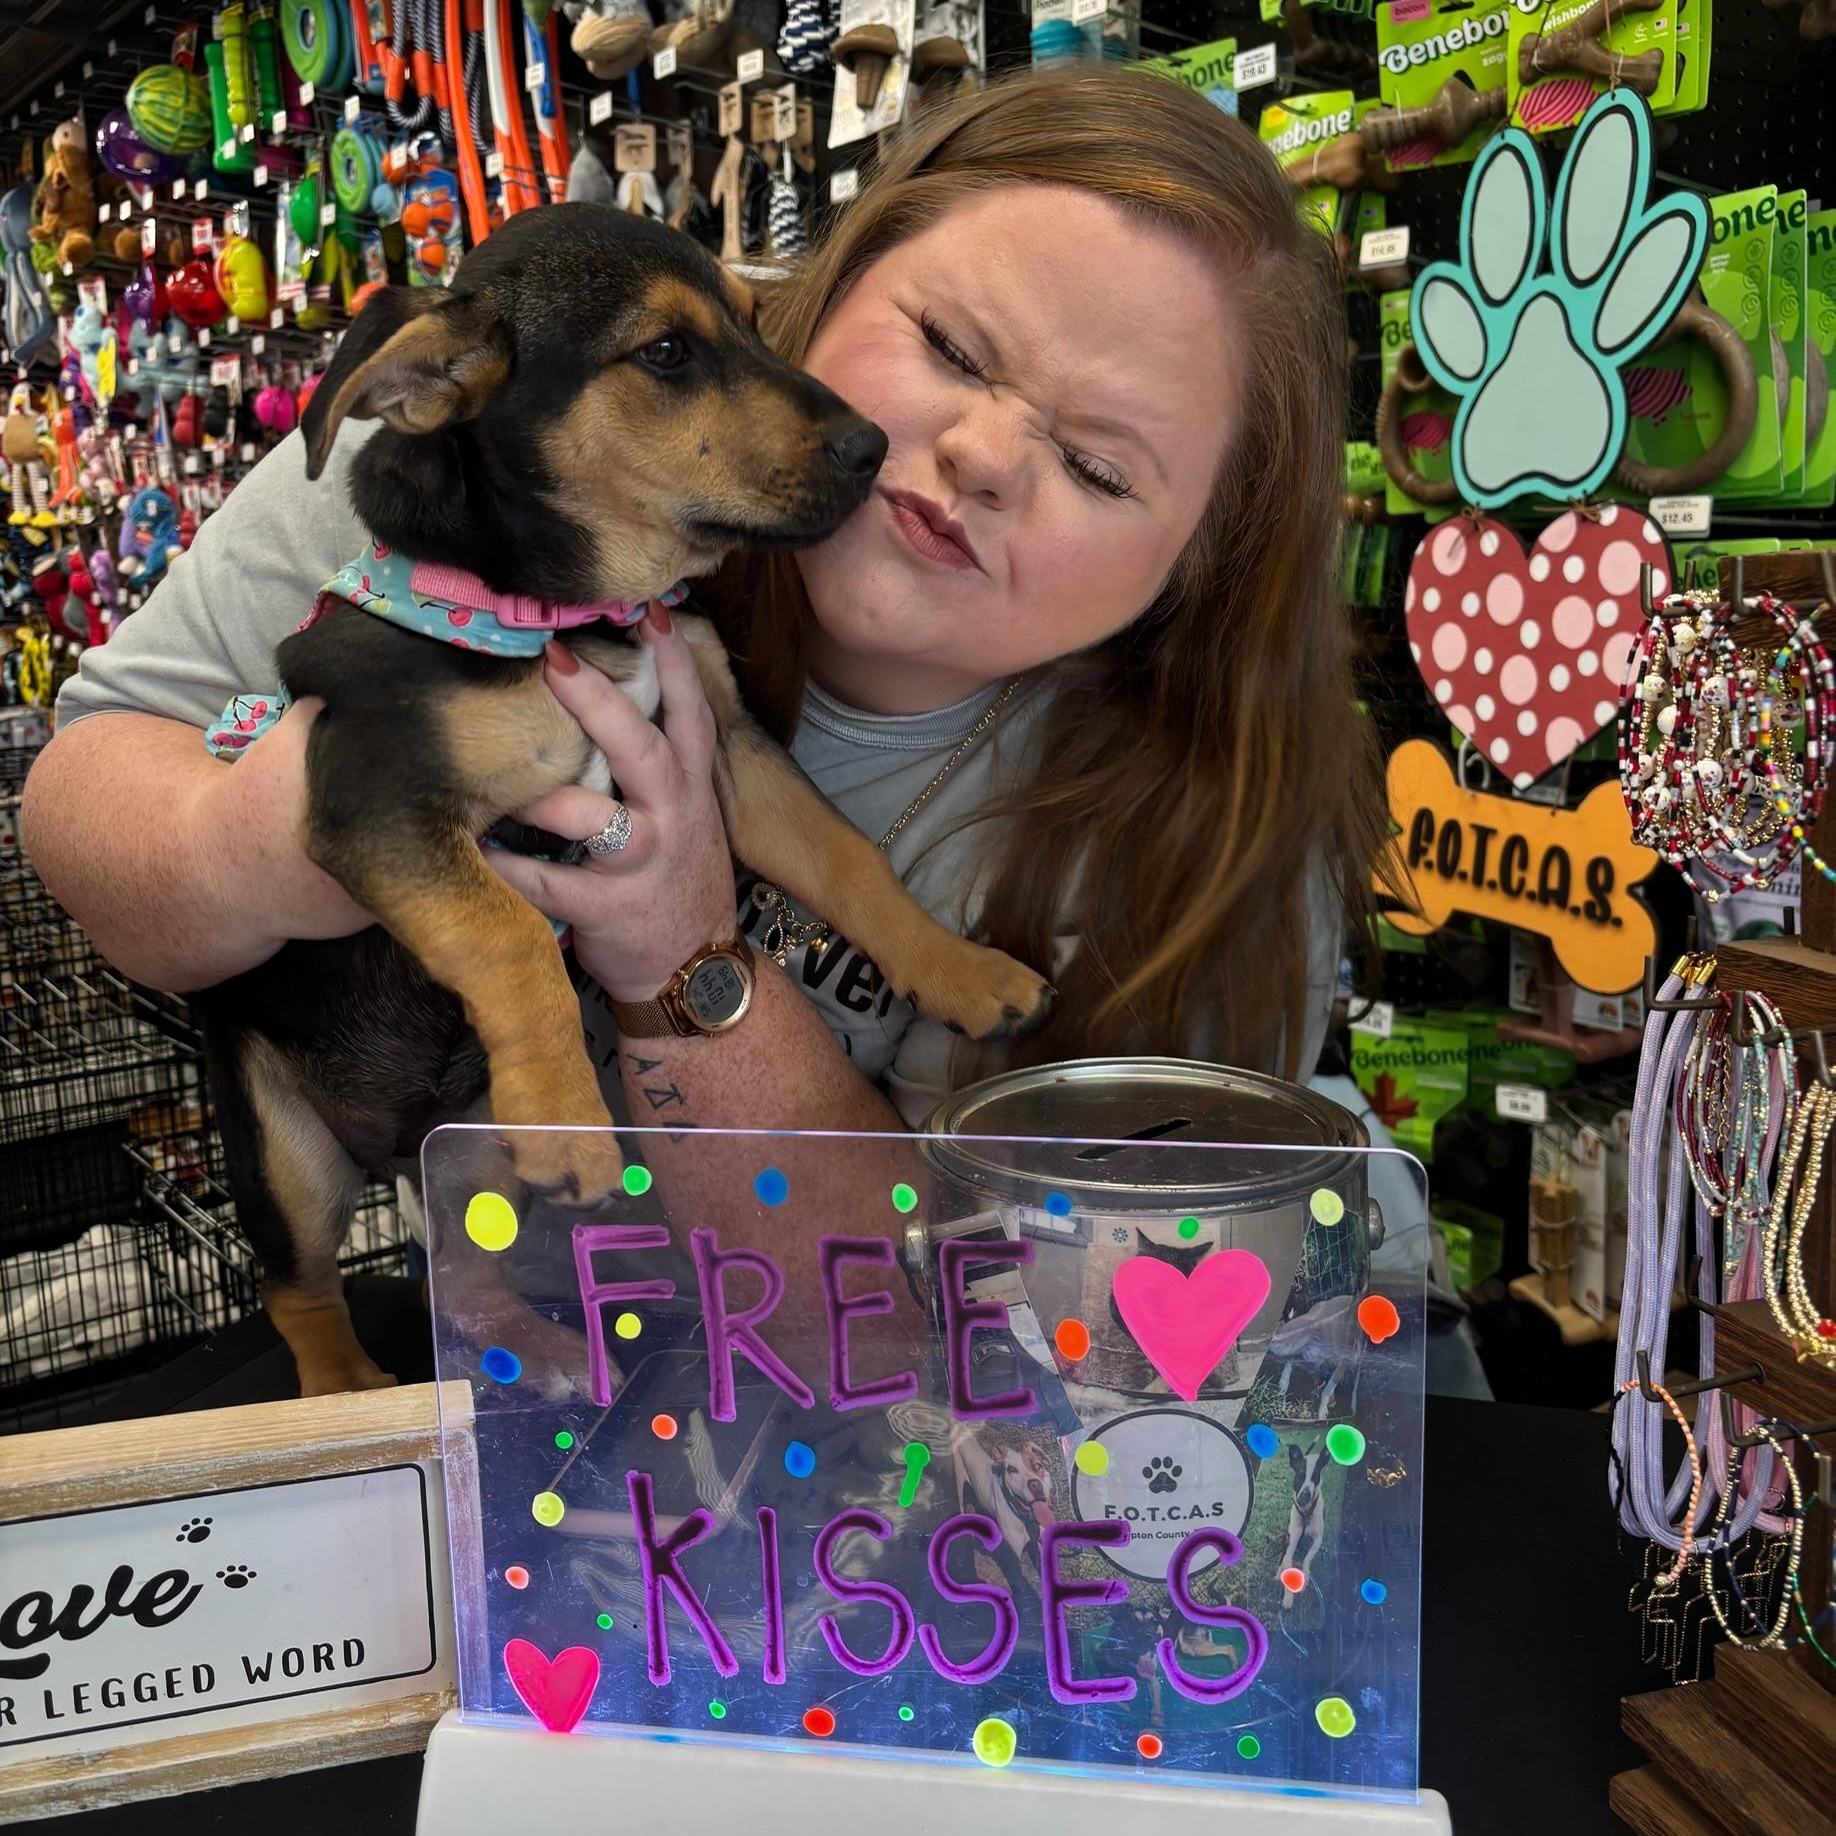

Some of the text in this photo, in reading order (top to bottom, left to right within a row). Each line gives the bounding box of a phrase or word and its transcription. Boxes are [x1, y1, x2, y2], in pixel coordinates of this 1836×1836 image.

[1408, 807, 1624, 928] F.O.T.C.A.S.
[572, 1223, 1040, 1423] FREE
[1104, 1501, 1225, 1522] F.O.T.C.A.S
[626, 1470, 1268, 1706] KISSES
[43, 1662, 216, 1720] LEGGED
[241, 1637, 366, 1685] WORD
